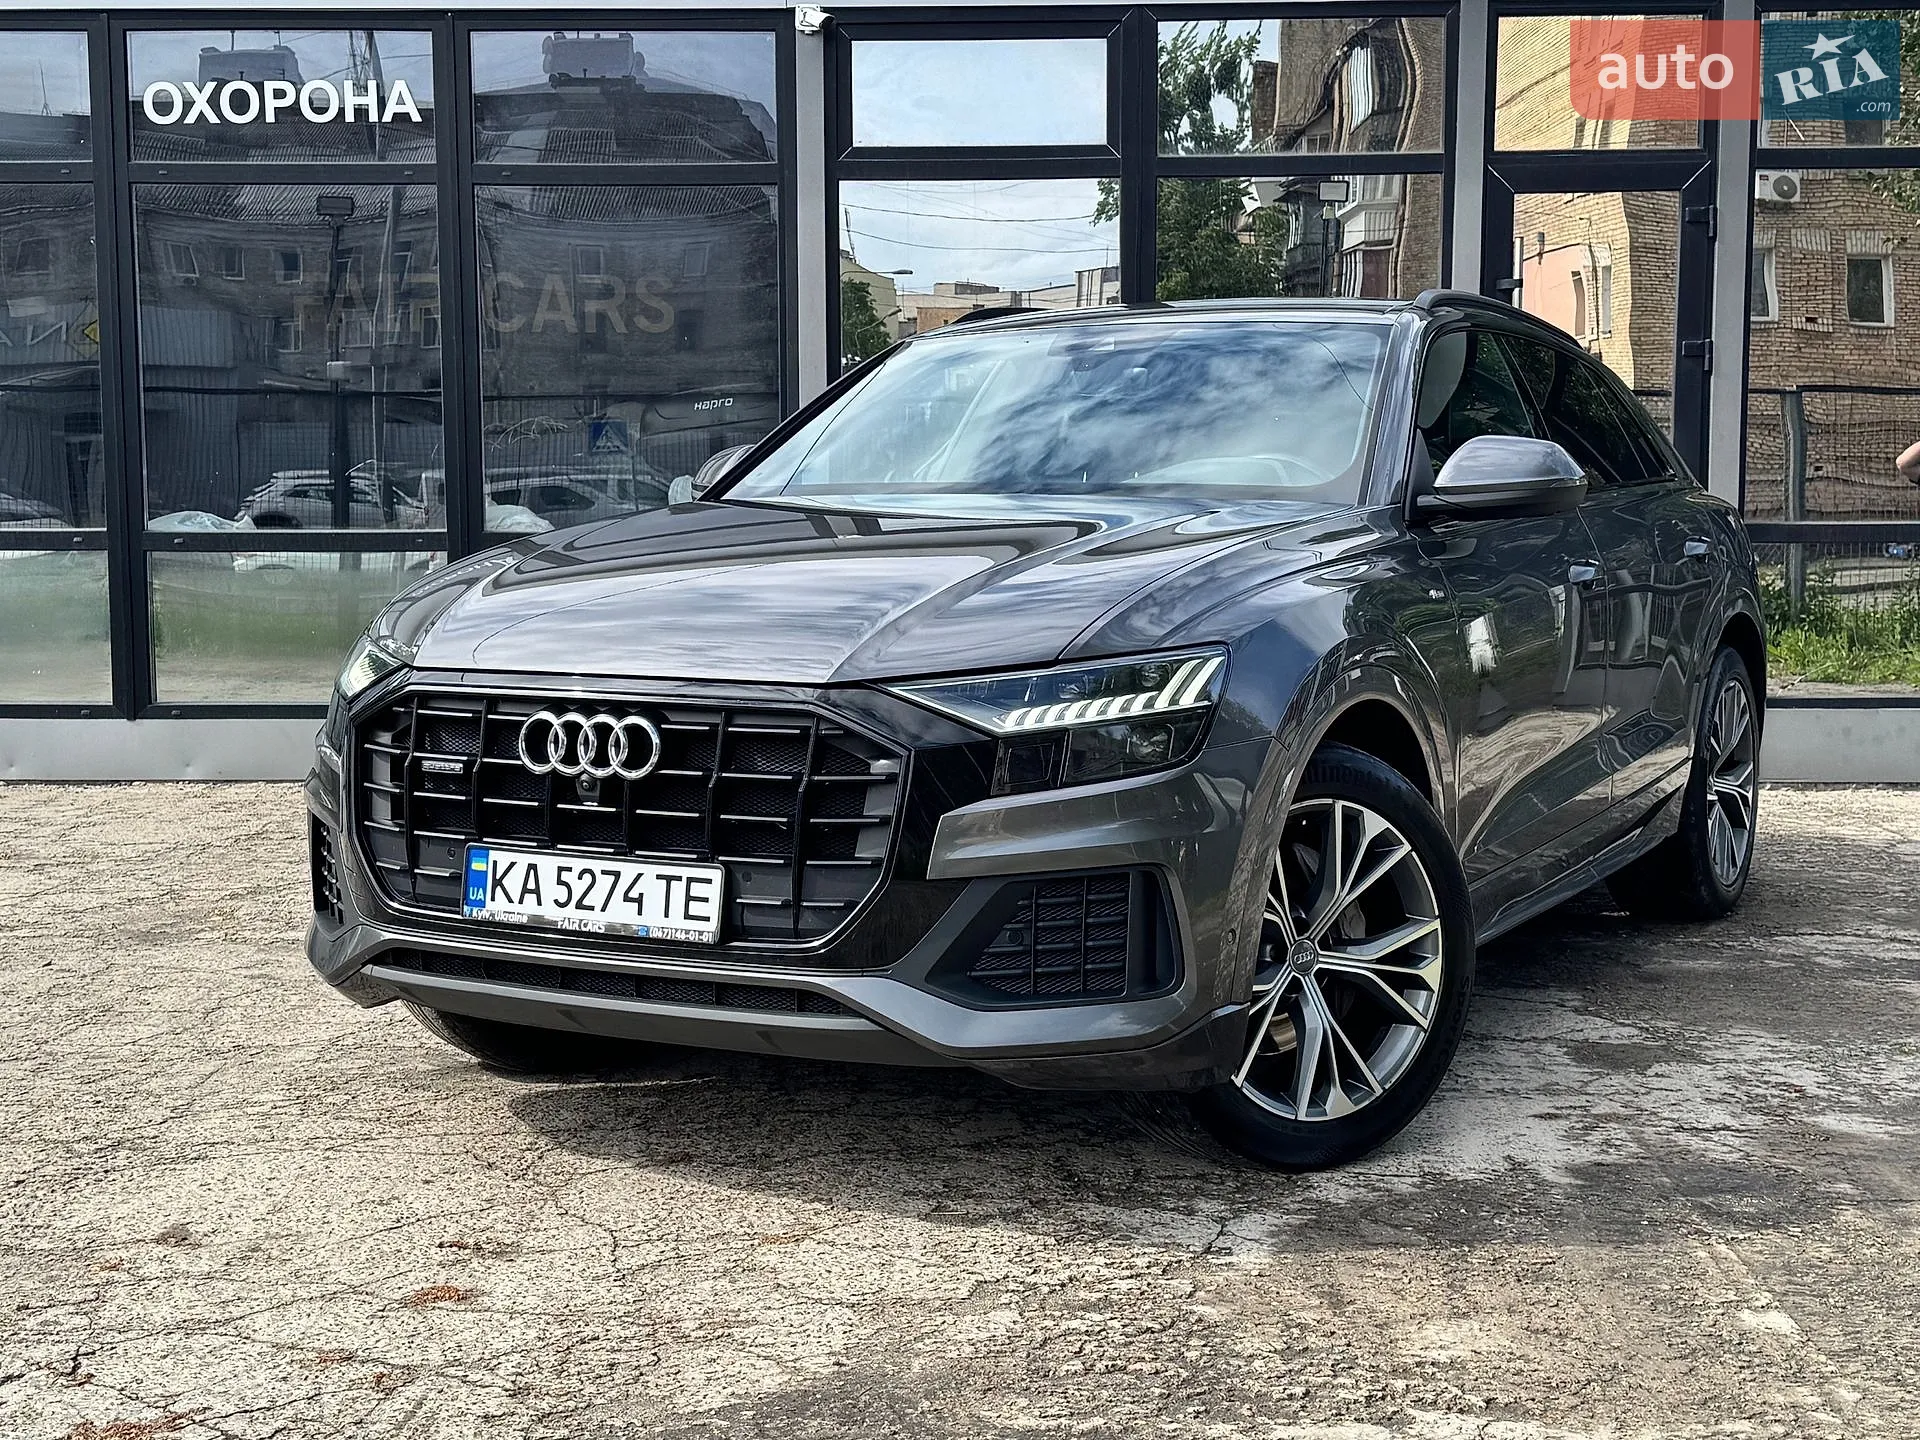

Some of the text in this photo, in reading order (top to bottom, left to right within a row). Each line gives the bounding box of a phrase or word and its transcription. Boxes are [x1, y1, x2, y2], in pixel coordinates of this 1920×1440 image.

[143, 79, 423, 125] ОХОРОНА
[484, 271, 676, 335] CARS
[469, 886, 485, 901] UA
[490, 859, 713, 923] KA 5274 TE
[495, 909, 529, 924] Ukraine
[581, 919, 606, 934] CARS
